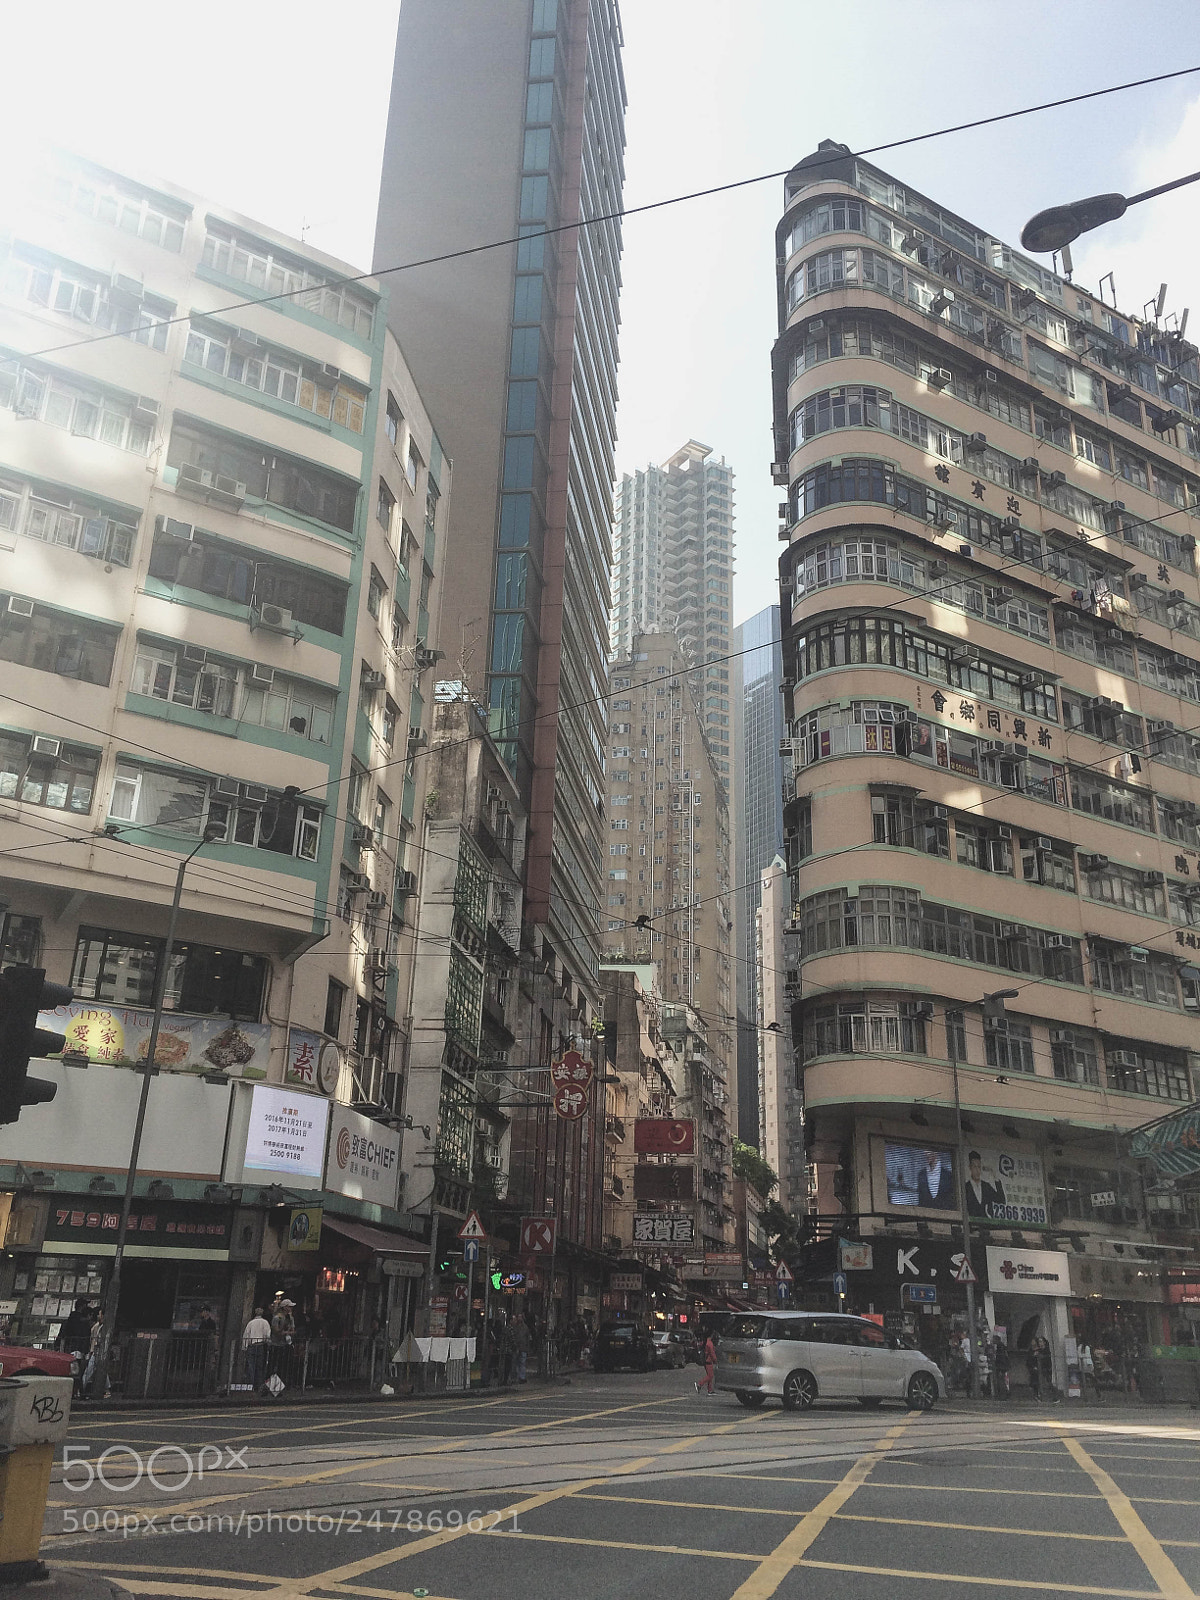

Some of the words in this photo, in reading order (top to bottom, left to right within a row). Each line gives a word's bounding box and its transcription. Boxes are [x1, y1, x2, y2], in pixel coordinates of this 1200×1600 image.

[73, 1024, 118, 1045] 愛家
[164, 1023, 191, 1034] vegan
[293, 1042, 315, 1081] 素
[367, 1141, 395, 1169] CHIEF
[993, 1204, 1018, 1220] 2366
[1020, 1207, 1045, 1223] 3939
